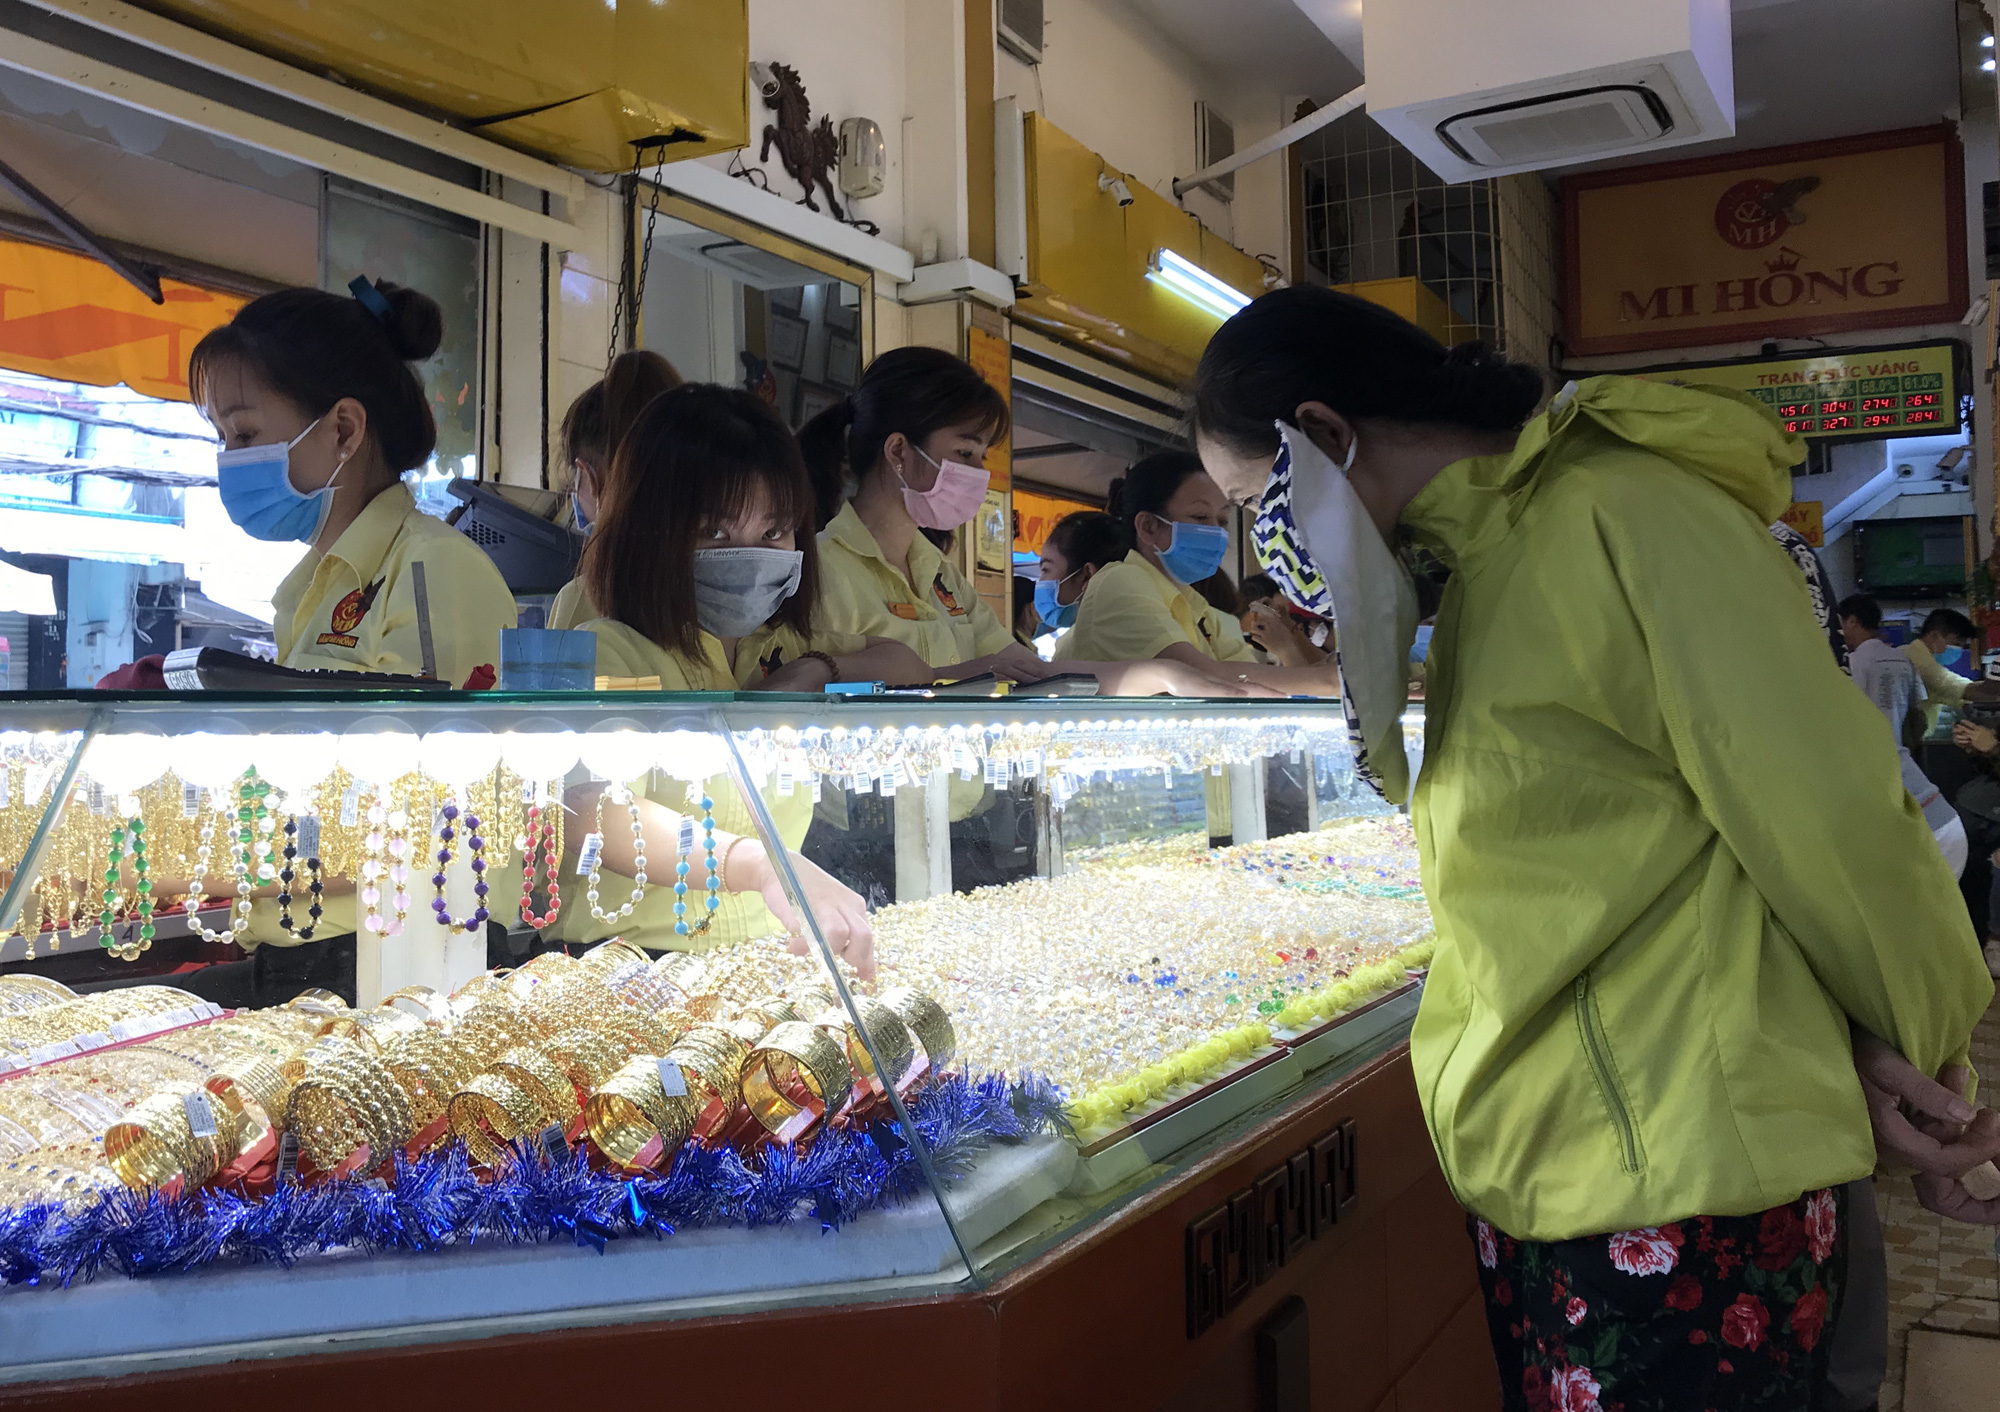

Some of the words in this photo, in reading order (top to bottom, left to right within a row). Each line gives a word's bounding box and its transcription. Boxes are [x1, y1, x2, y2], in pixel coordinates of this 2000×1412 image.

[1728, 217, 1777, 245] MH
[1616, 284, 1700, 323] MI
[1757, 370, 1818, 386] TRANG
[122, 924, 134, 942] 4
